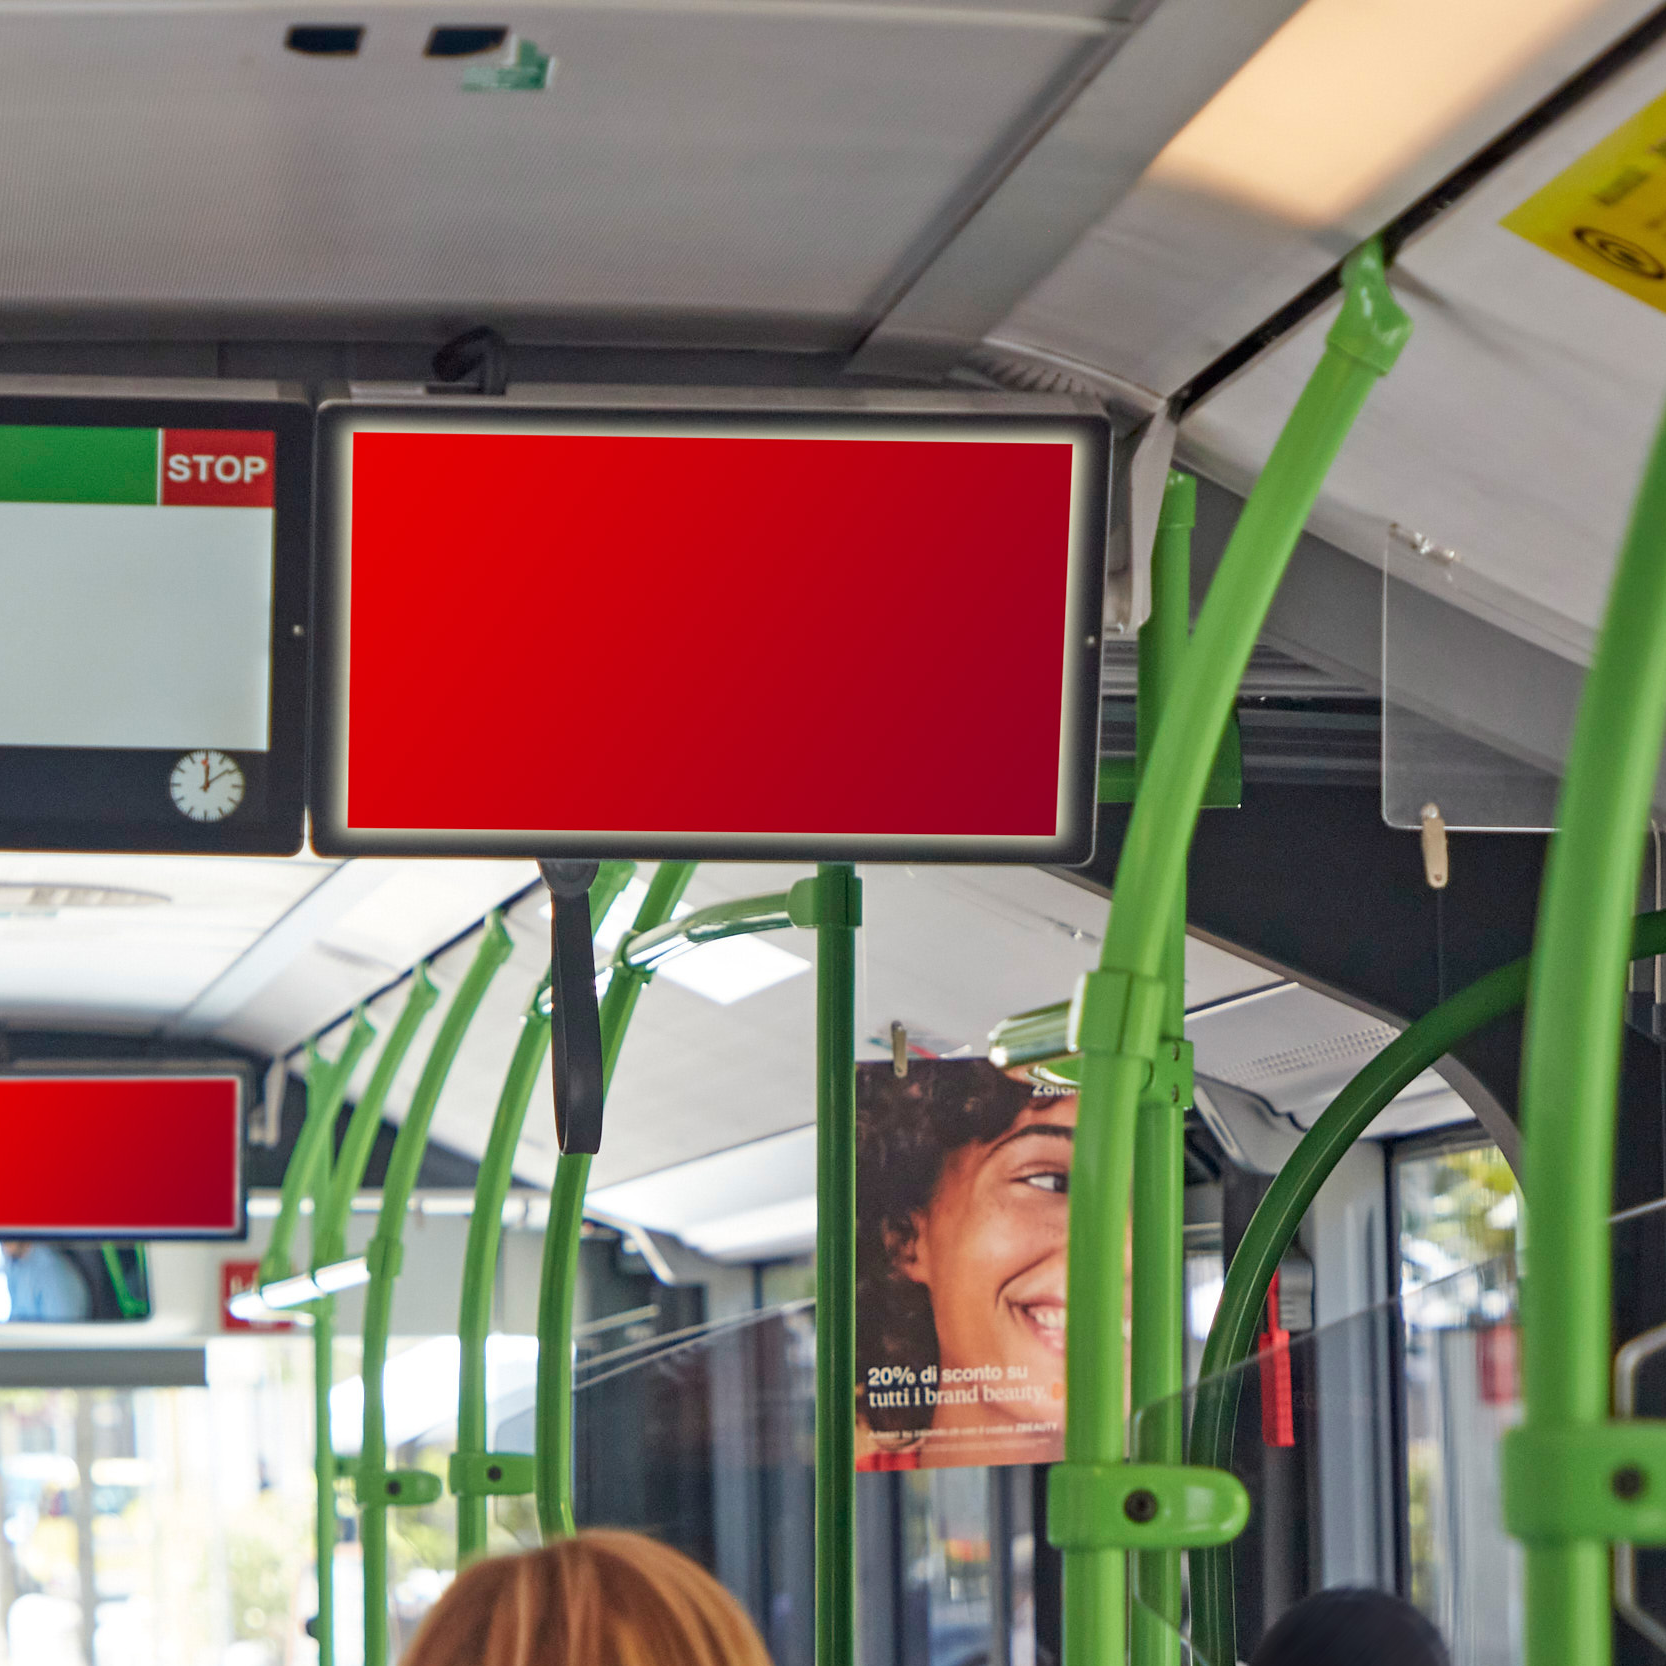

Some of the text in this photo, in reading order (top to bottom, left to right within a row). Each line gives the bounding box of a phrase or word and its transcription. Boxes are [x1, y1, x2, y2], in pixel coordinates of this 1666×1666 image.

[167, 453, 268, 483] STOP
[867, 1364, 1029, 1387] 20% di sconto su
[868, 1382, 1048, 1408] tutti i brand beauty.
